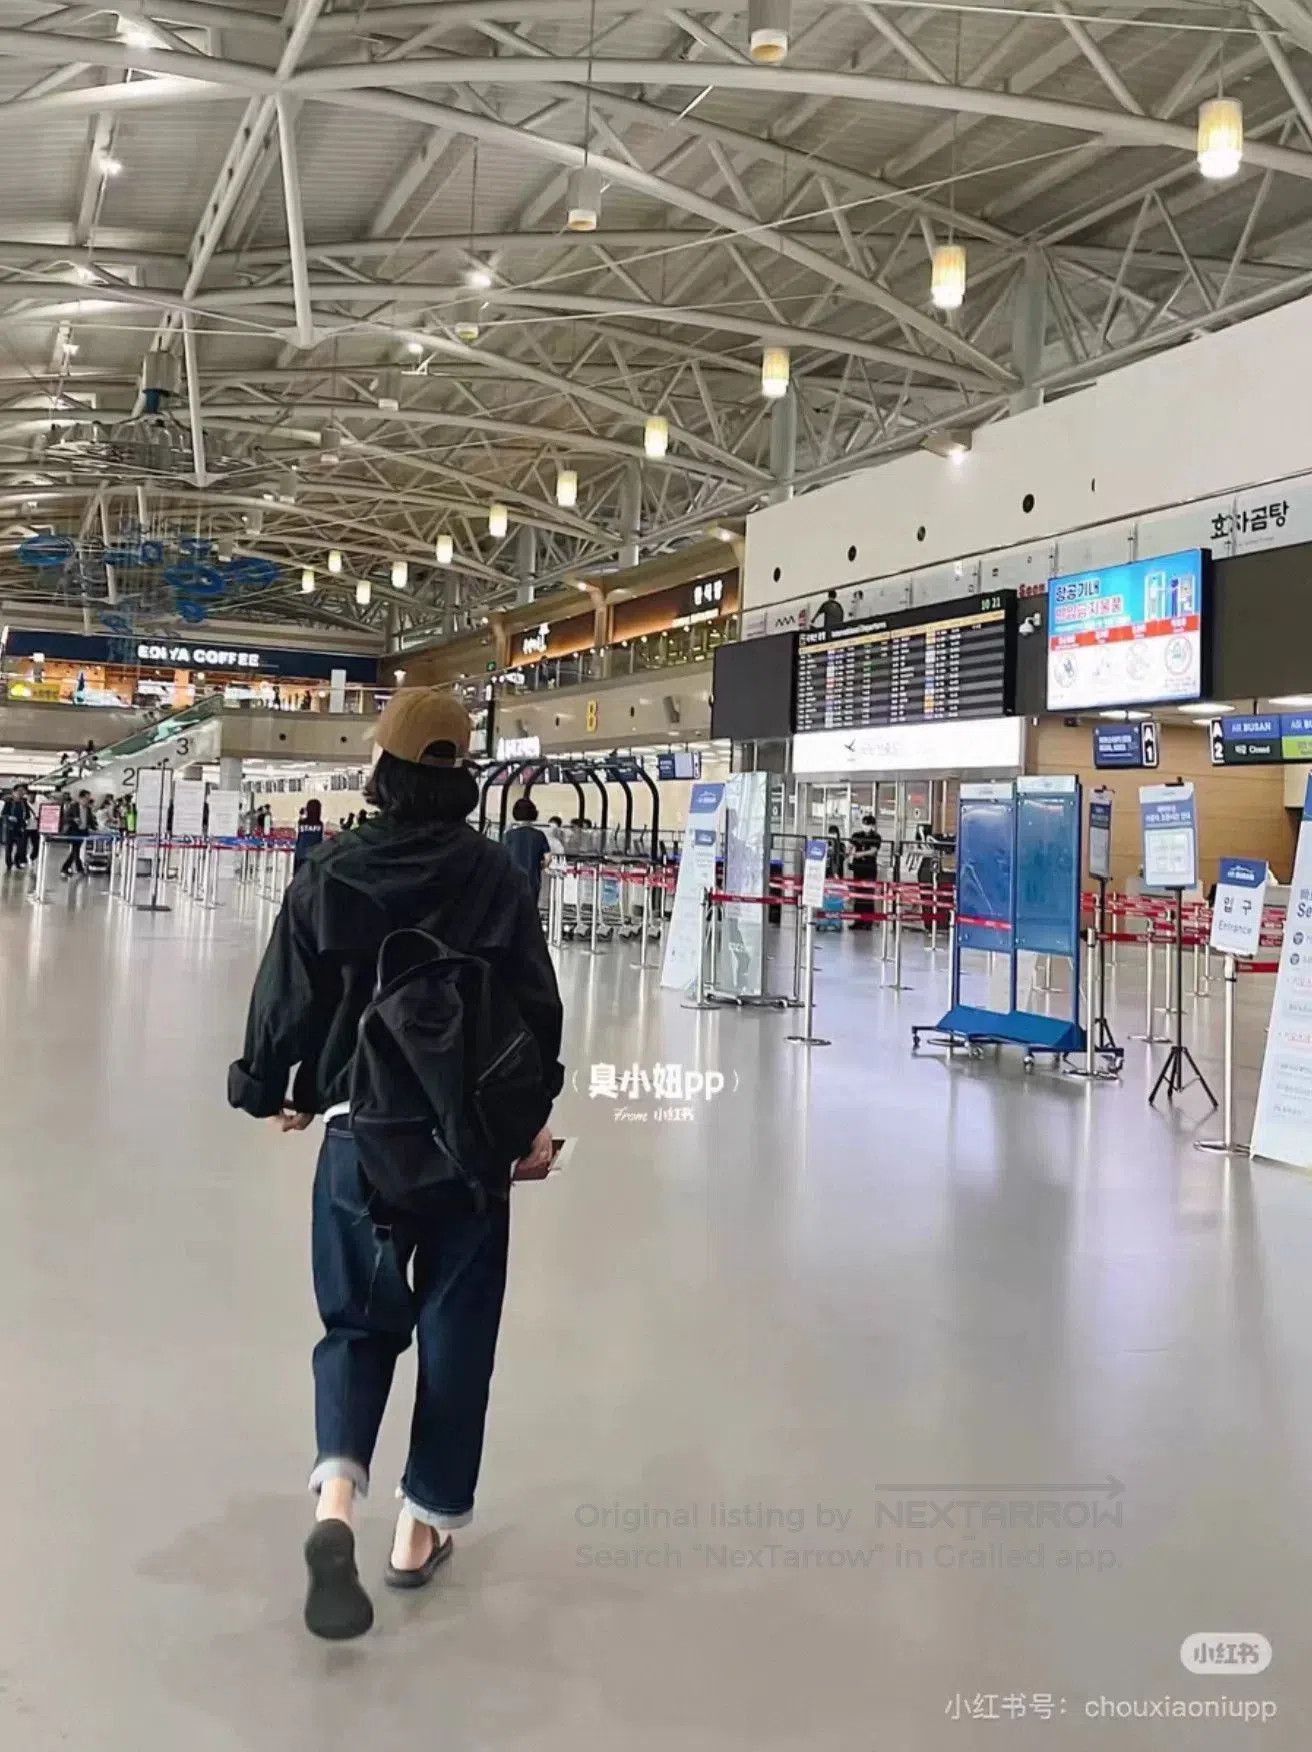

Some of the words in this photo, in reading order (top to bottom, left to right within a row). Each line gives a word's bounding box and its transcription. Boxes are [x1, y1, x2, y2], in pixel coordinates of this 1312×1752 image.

[194, 649, 260, 667] COFFEE
[587, 700, 598, 733] B
[1145, 726, 1153, 741] A
[1213, 720, 1224, 737] A
[176, 738, 189, 755] 3
[1146, 746, 1153, 761] 1
[1215, 744, 1224, 758] 2
[122, 767, 135, 786] 2
